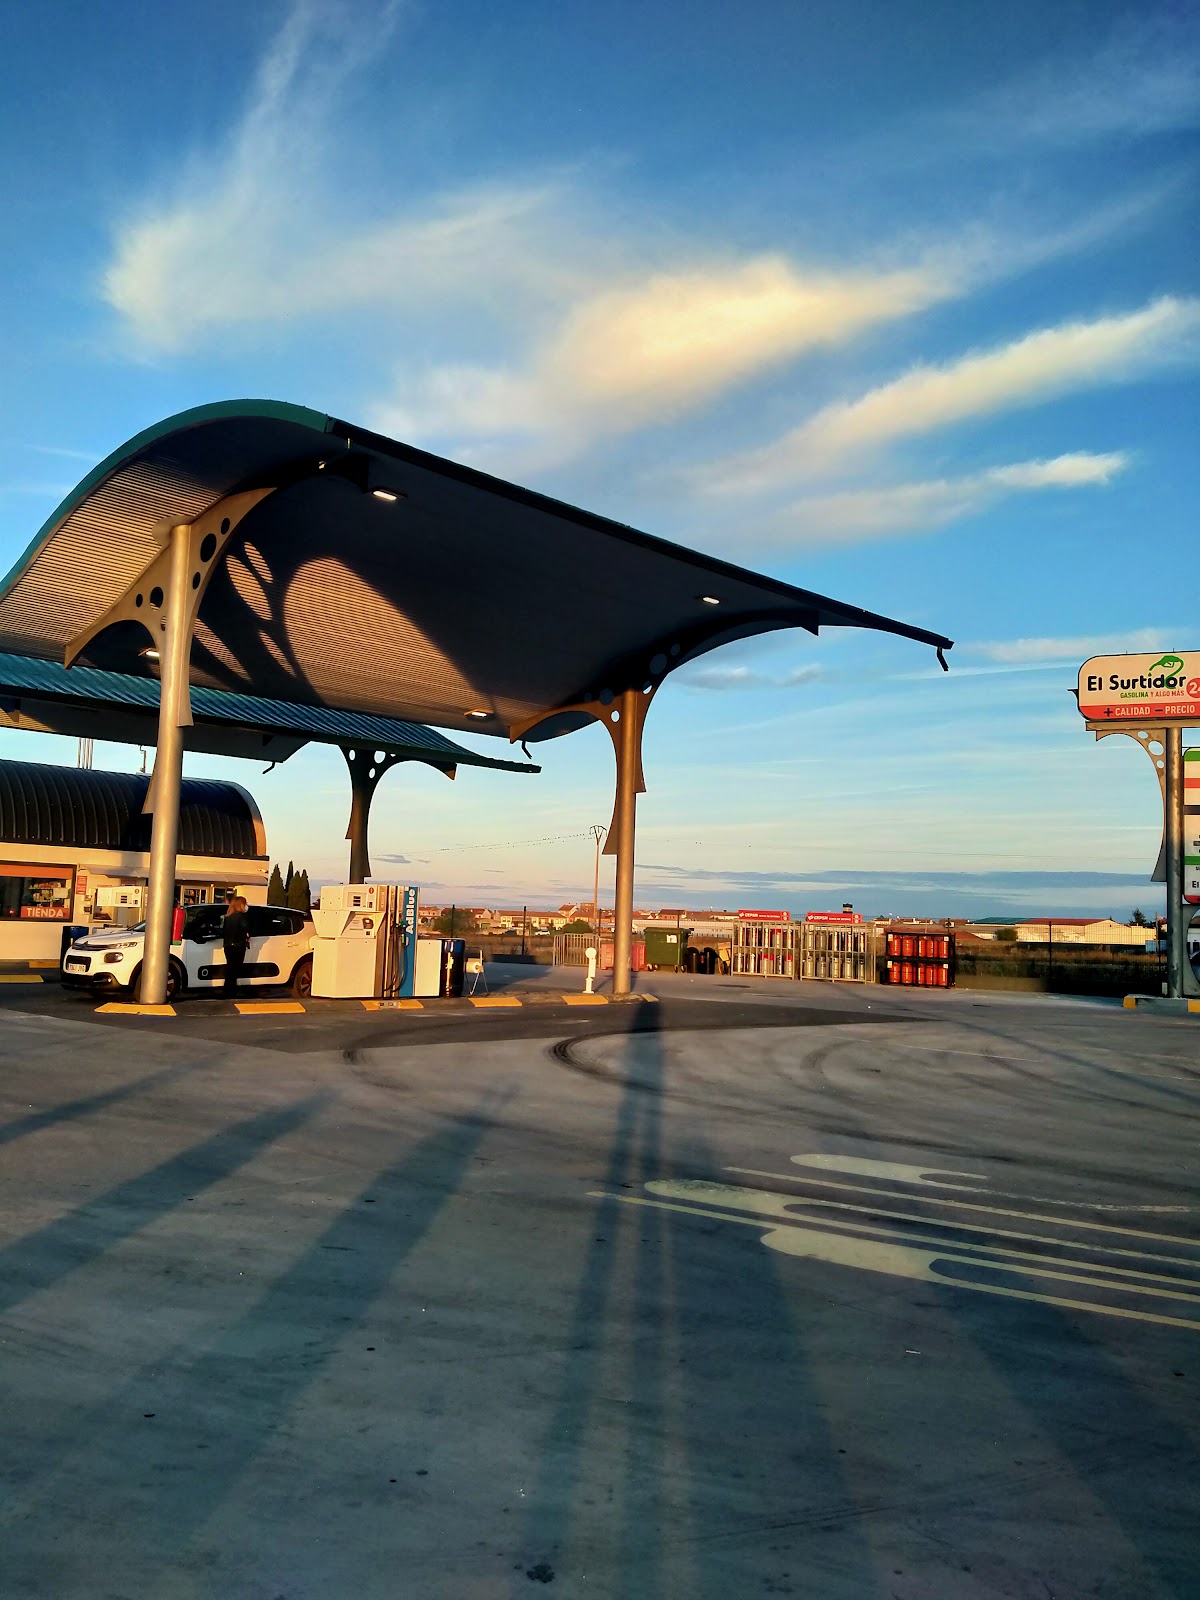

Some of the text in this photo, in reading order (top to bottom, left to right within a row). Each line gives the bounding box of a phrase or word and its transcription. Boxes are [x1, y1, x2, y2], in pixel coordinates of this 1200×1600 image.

[1087, 673, 1187, 691] El Surtidor
[1171, 689, 1185, 697] MÁS
[1115, 706, 1151, 716] CALIDAD
[1165, 704, 1195, 714] PRECIO
[26, 907, 64, 918] TIENDA
[405, 889, 416, 935] AdBlue
